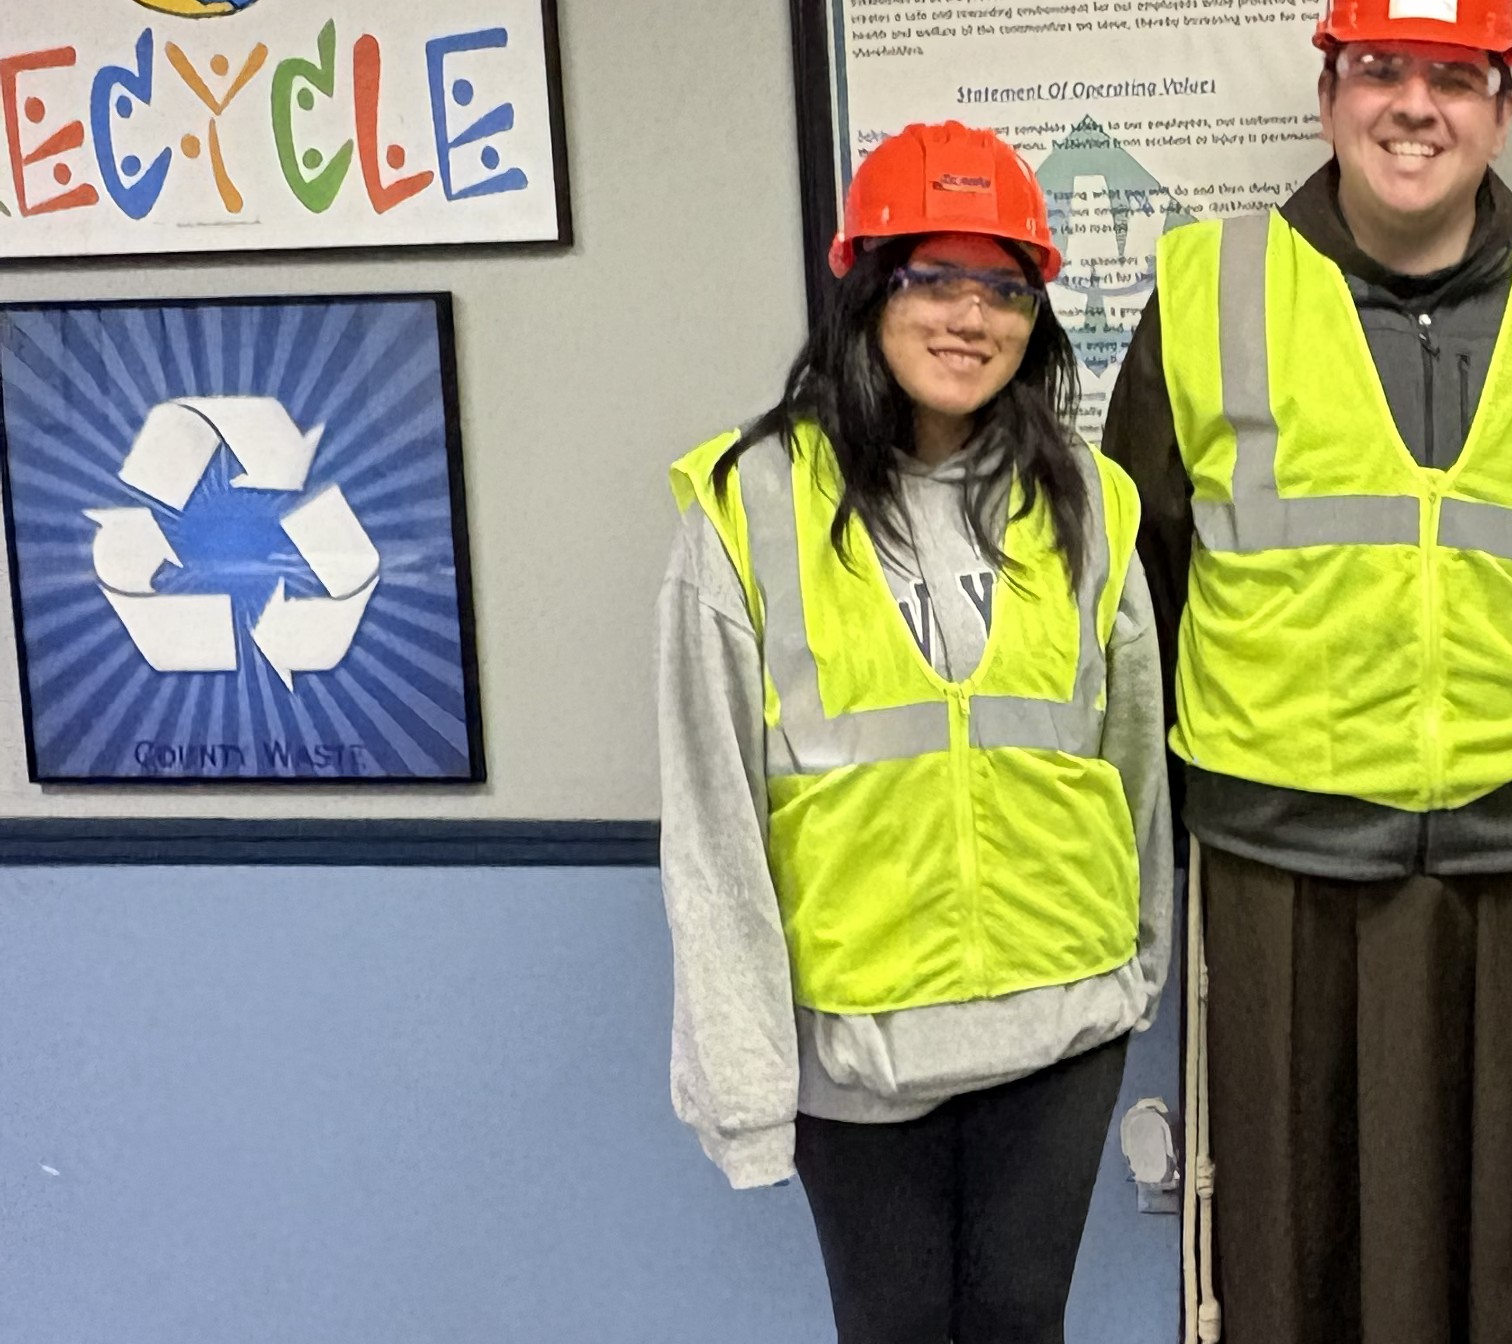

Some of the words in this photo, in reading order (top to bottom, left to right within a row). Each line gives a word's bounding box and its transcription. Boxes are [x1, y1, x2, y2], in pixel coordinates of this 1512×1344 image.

[0, 18, 529, 219] ECYCLE
[957, 83, 1042, 104] Statement
[1072, 78, 1156, 99] Operating
[1161, 76, 1216, 96] Values
